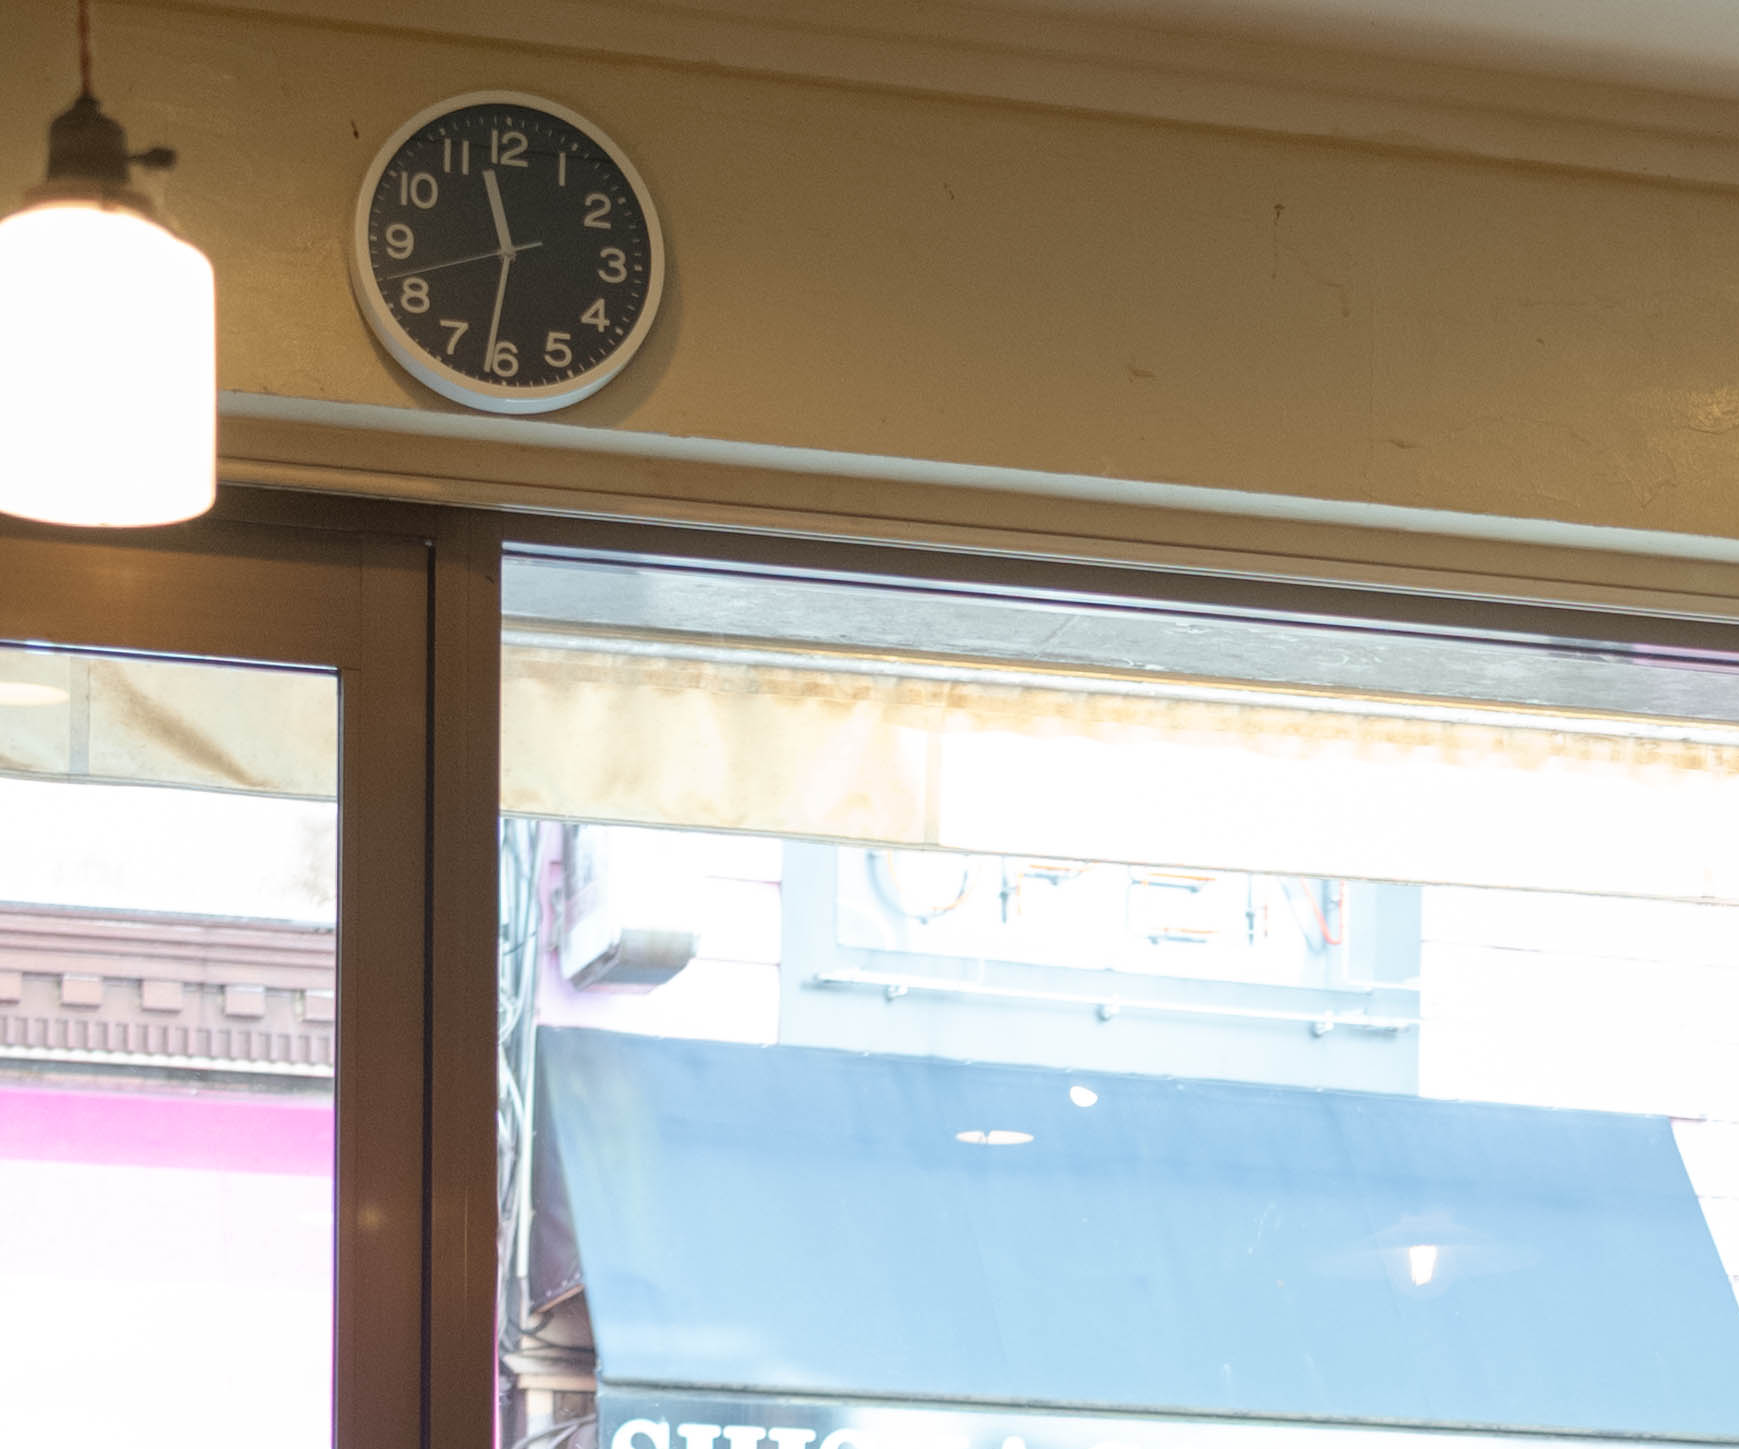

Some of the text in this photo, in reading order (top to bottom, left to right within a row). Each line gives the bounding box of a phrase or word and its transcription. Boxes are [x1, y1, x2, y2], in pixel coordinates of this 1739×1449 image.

[444, 138, 469, 176] 11
[491, 130, 529, 168] 12
[559, 152, 567, 187] 1
[401, 171, 439, 209] 10
[583, 193, 612, 230] 2
[385, 224, 415, 260] 9
[597, 249, 628, 284] 3
[400, 277, 431, 314] 8
[581, 298, 610, 333] 4
[440, 320, 469, 355] 7
[544, 332, 573, 368] 5
[492, 342, 519, 378] 6
